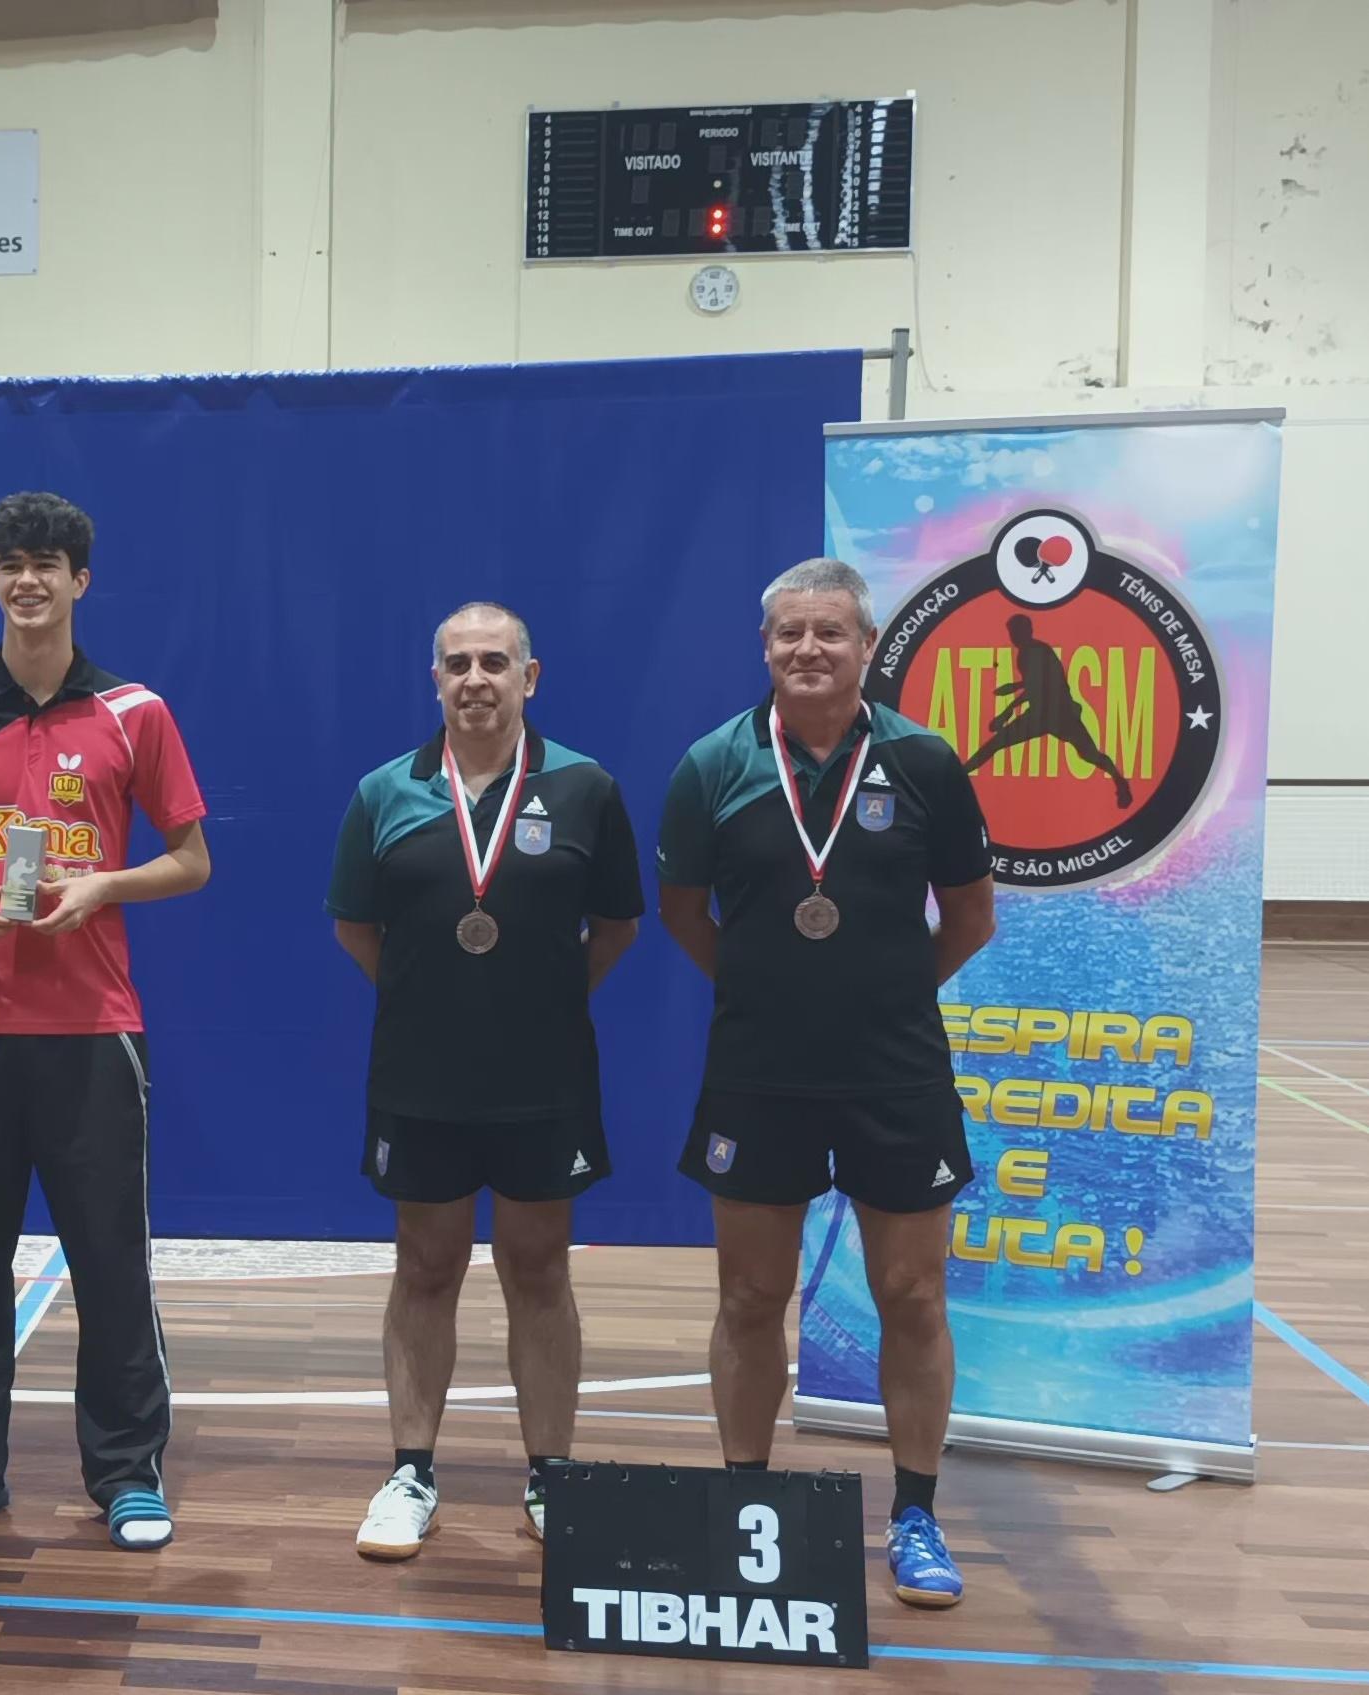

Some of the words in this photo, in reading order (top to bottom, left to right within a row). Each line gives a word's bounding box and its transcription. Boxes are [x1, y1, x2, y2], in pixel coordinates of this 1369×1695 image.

[545, 115, 551, 124] 4
[545, 127, 551, 137] 5
[699, 128, 739, 138] PERIODO
[544, 139, 551, 149] 6
[544, 151, 551, 160] 7
[544, 162, 551, 172] 8
[625, 154, 681, 170] VISITADO
[543, 175, 551, 185] 9
[538, 186, 550, 196] 10
[537, 199, 549, 208] 11
[537, 210, 550, 220] 12
[537, 222, 549, 232] 13
[613, 227, 633, 237] TIME
[635, 227, 654, 237] OUT
[537, 235, 549, 244] 14
[536, 246, 549, 256] 15
[880, 581, 960, 679] ASSOCIAÇÃO
[1119, 572, 1164, 613] TÉNIS
[1158, 610, 1184, 635] DE
[1174, 633, 1206, 684] MESA
[1012, 859, 1052, 876] SÃO
[1058, 835, 1133, 875] MIGUEL
[937, 1003, 1194, 1067] ESPIRA
[954, 1075, 1215, 1141] REDITA
[995, 1148, 1050, 1197] E
[946, 1213, 1106, 1273] UTA
[738, 1504, 781, 1584] 3
[572, 1587, 838, 1654] TIBHAR
